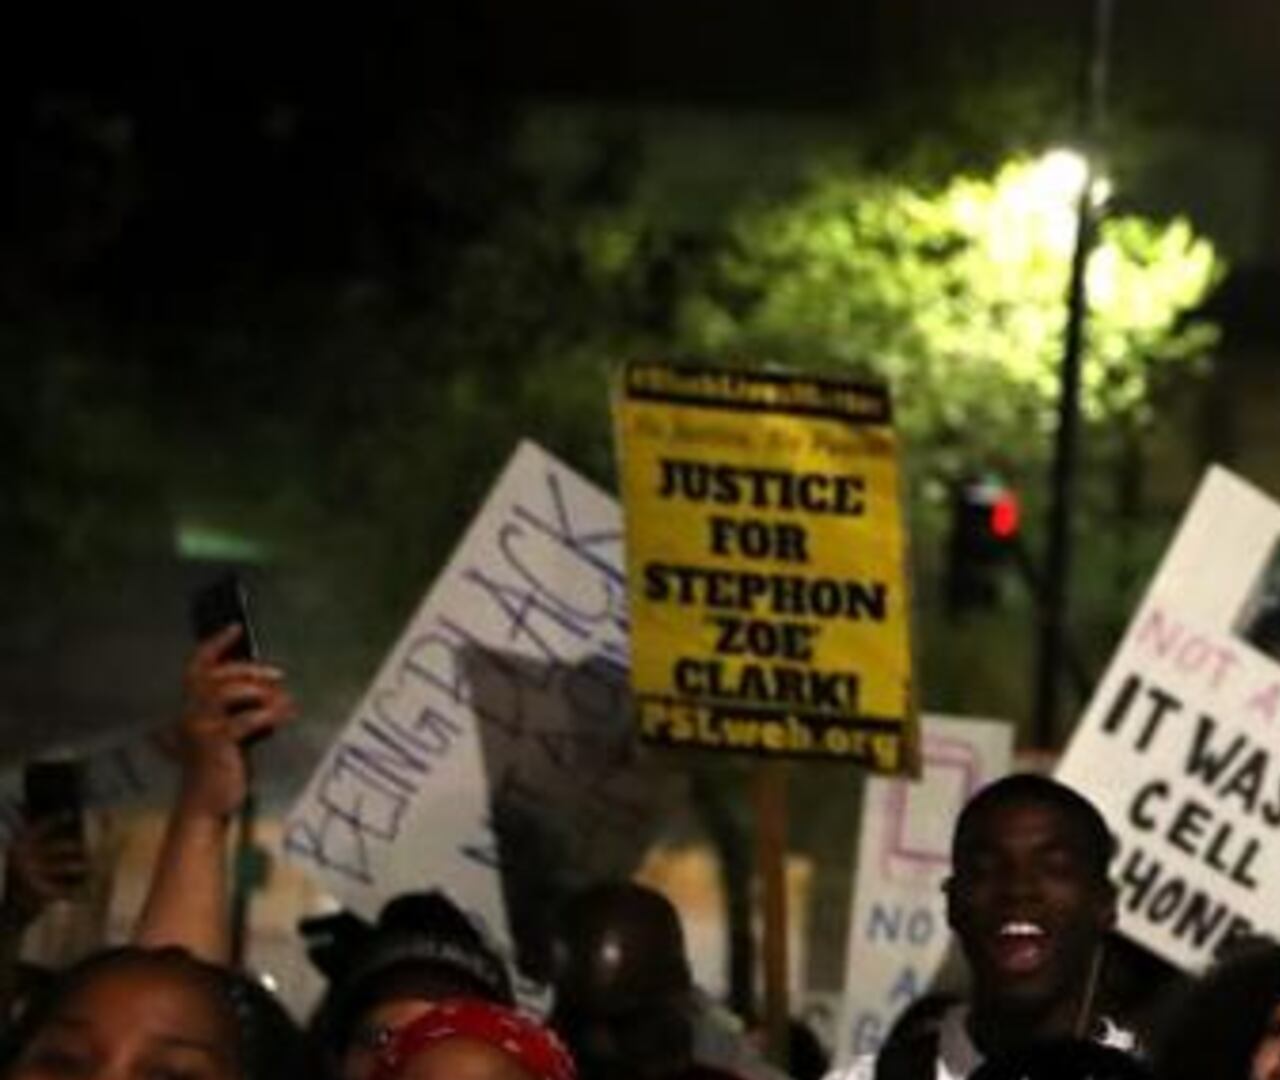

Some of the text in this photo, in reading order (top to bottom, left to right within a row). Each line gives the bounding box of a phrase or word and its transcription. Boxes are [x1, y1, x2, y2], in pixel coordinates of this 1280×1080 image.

[659, 458, 866, 518] JUSTICE
[708, 515, 808, 565] FOR
[642, 562, 890, 622] STEPHON
[674, 656, 862, 708] CLARK!
[1136, 606, 1240, 690] NOT
[1100, 672, 1184, 754] IT
[284, 688, 466, 886] BEING
[1126, 780, 1262, 893] CELL
